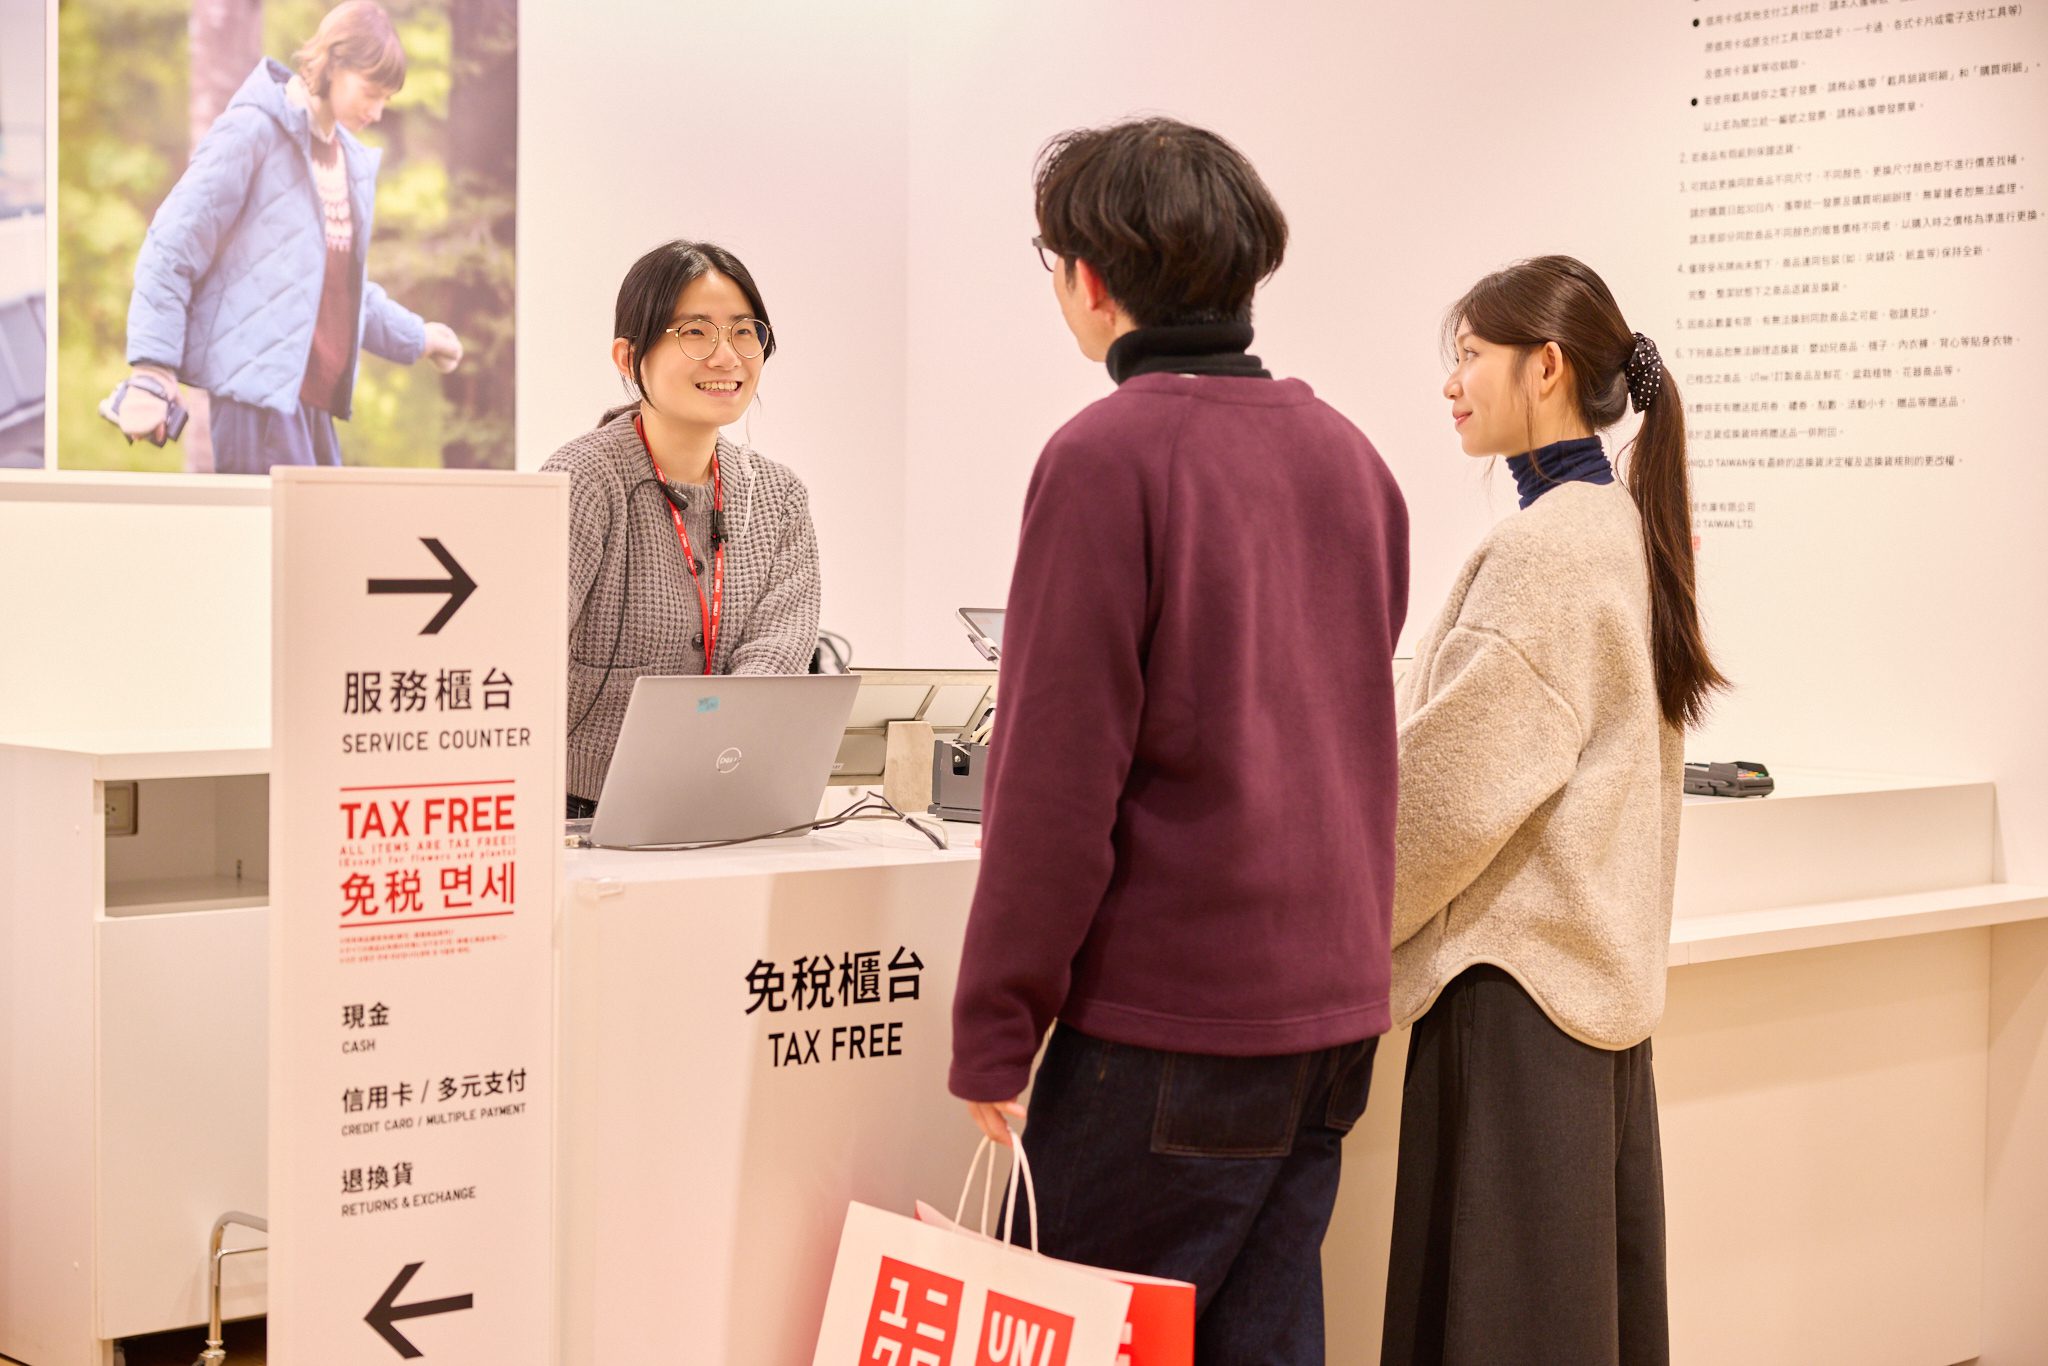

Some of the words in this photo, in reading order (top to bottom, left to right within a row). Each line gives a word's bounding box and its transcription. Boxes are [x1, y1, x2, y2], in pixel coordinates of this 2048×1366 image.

[343, 667, 514, 714] 服務櫃台
[342, 731, 429, 754] SERVICE
[439, 727, 531, 750] COUNTER
[340, 799, 410, 840] TAX
[424, 794, 515, 835] FREE
[340, 845, 364, 856] ALL
[372, 842, 409, 854] ITEMS
[417, 839, 441, 851] ARE
[449, 838, 470, 848] TAX
[440, 861, 515, 909] 면세
[744, 945, 925, 1015] 免稅櫃台
[342, 1002, 391, 1029] 現金
[341, 1039, 376, 1054] CASH
[768, 1029, 821, 1068] TAX
[832, 1022, 904, 1062] FREE
[342, 1082, 414, 1114] 信用卡
[438, 1067, 527, 1103] 多元支付
[341, 1121, 380, 1137] CREDIT
[384, 1117, 414, 1132] CARD
[426, 1108, 476, 1126] MULTIPLE
[480, 1102, 527, 1118] PAYMENT
[341, 1162, 414, 1195] 退換貨
[341, 1196, 398, 1217] RETURNS
[401, 1196, 411, 1209] &
[413, 1186, 477, 1207] EXCHANGE
[987, 1310, 1057, 1366] UNI
